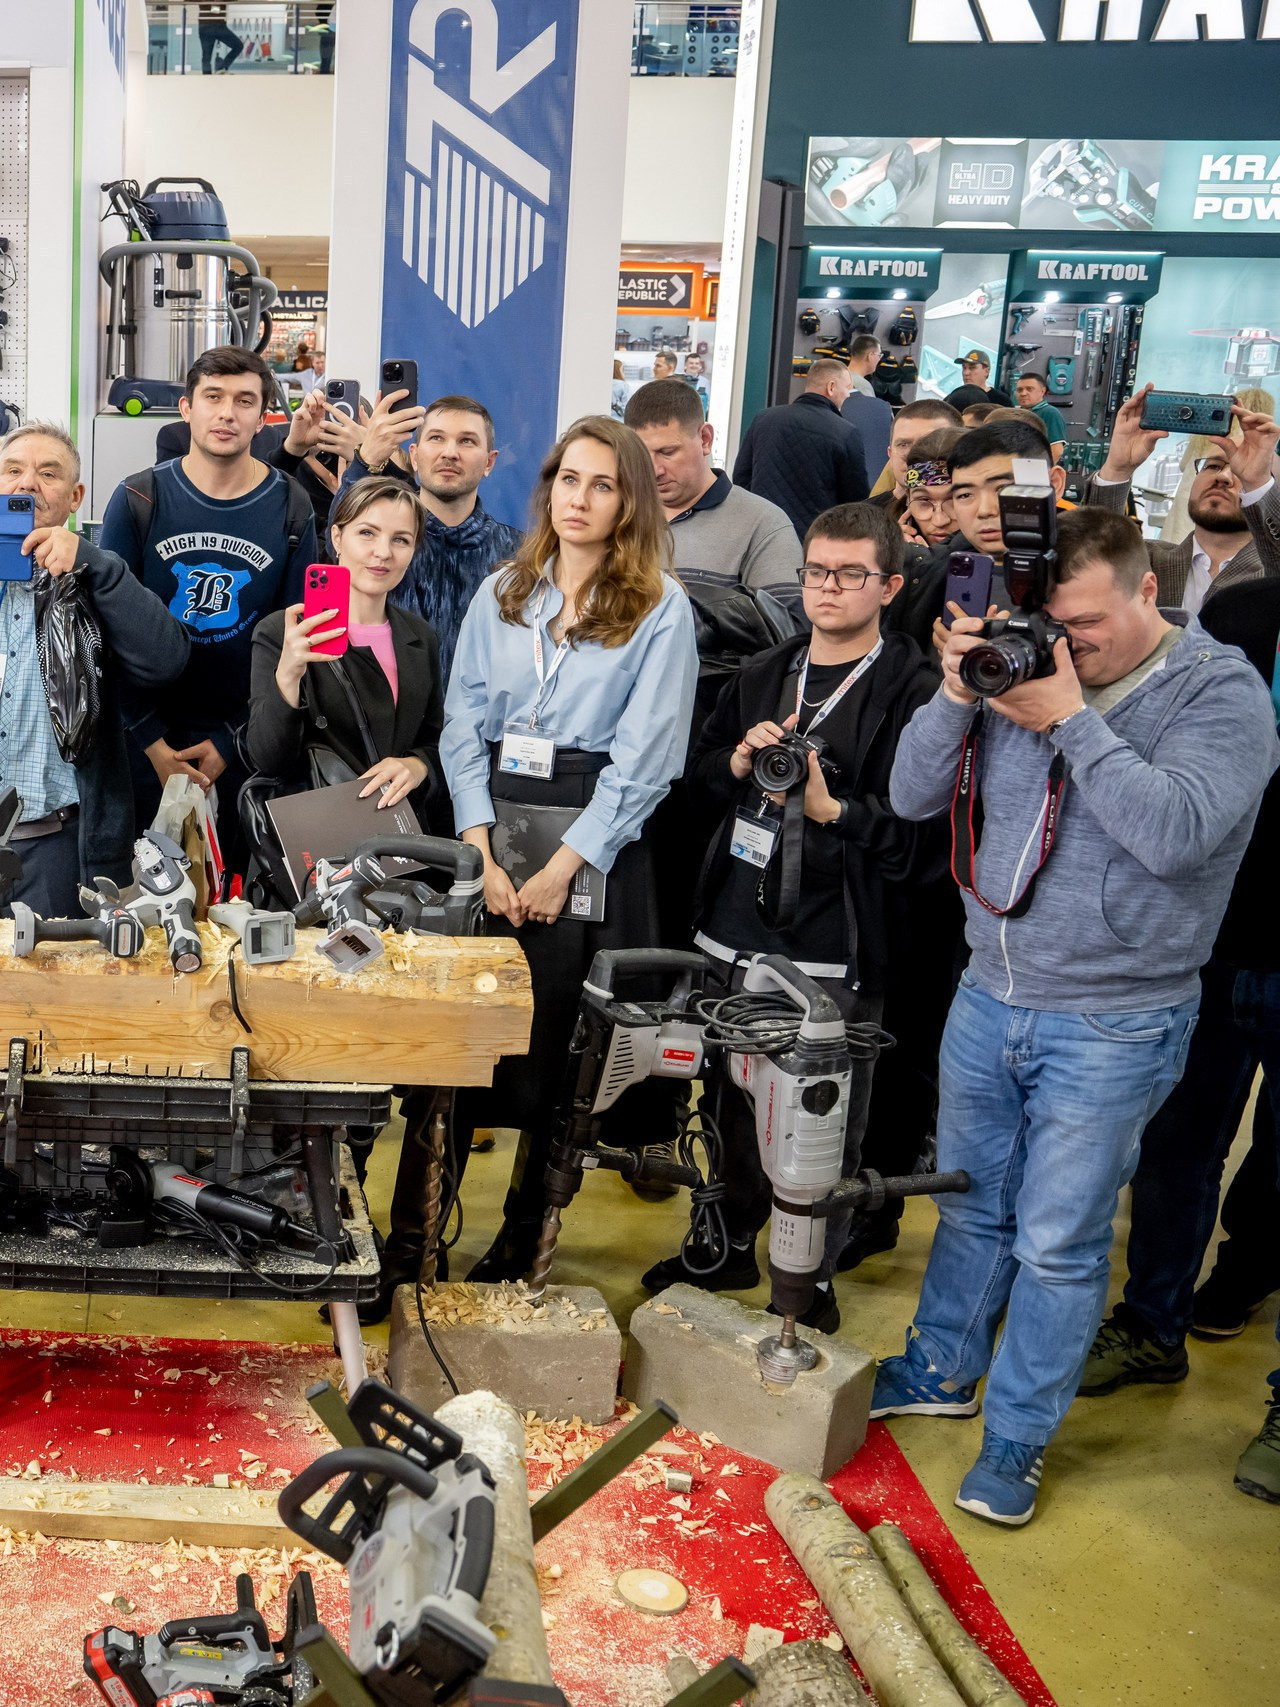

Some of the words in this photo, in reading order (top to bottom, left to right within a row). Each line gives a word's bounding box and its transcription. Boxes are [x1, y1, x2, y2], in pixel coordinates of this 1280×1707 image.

[949, 163, 1015, 190] HD
[955, 172, 976, 181] ULTRA
[948, 194, 982, 206] HEAVY
[984, 194, 1011, 206] DUTY
[819, 256, 928, 278] KRAFTOOL
[1038, 260, 1149, 282] KRAFTOOL
[618, 278, 668, 290] LASTIC
[618, 290, 667, 301] EPUBLIC
[163, 536, 197, 556] HIGH
[201, 535, 218, 548] N9
[220, 538, 268, 567] DIVISION
[1008, 620, 1029, 628] Canon
[189, 634, 211, 644] oncept
[837, 675, 857, 697] mitex
[959, 748, 972, 795] Canon
